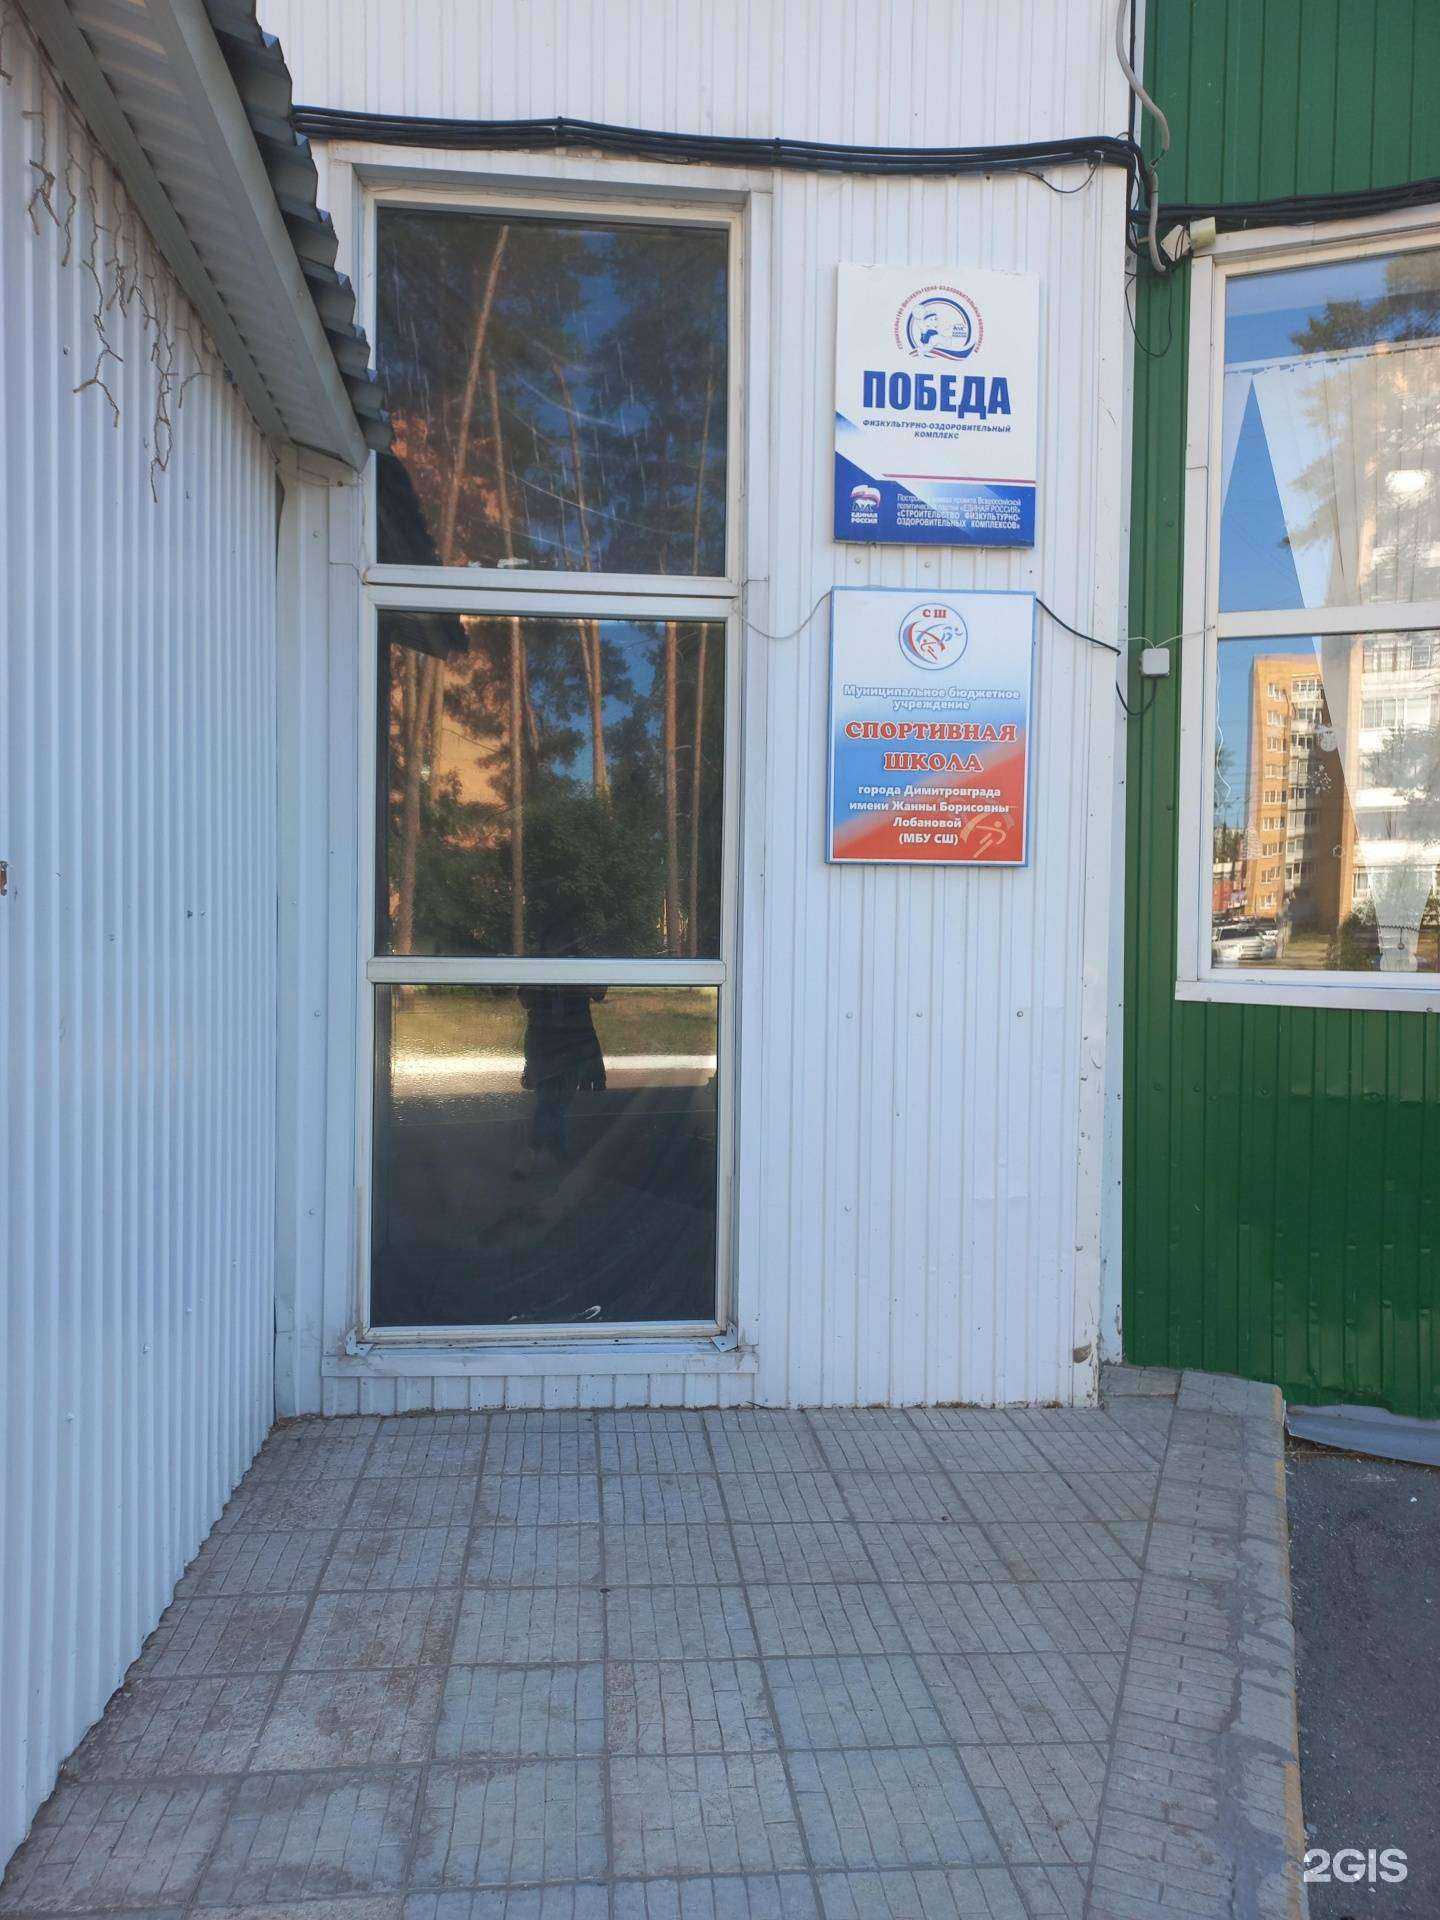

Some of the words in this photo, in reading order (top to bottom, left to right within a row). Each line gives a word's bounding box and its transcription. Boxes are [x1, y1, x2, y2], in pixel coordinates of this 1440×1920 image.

[863, 371, 1011, 419] ПОБЕДА
[914, 431, 959, 440] КОМПЛЕКС
[844, 685, 945, 698] Муниципальное
[947, 688, 1020, 699] бюджетное
[893, 701, 970, 710] учреждение
[845, 721, 1017, 742] СПОРТИВНАЯ
[884, 752, 983, 772] ШКОЛА
[858, 786, 901, 797] города
[904, 785, 1001, 798] Димитровграда
[849, 801, 888, 811] имени
[892, 801, 936, 812] Жанны
[939, 802, 1009, 813] Борисовны
[893, 817, 961, 828] Лобановой
[899, 834, 930, 845] (МБУ
[934, 834, 958, 845] СШ)
